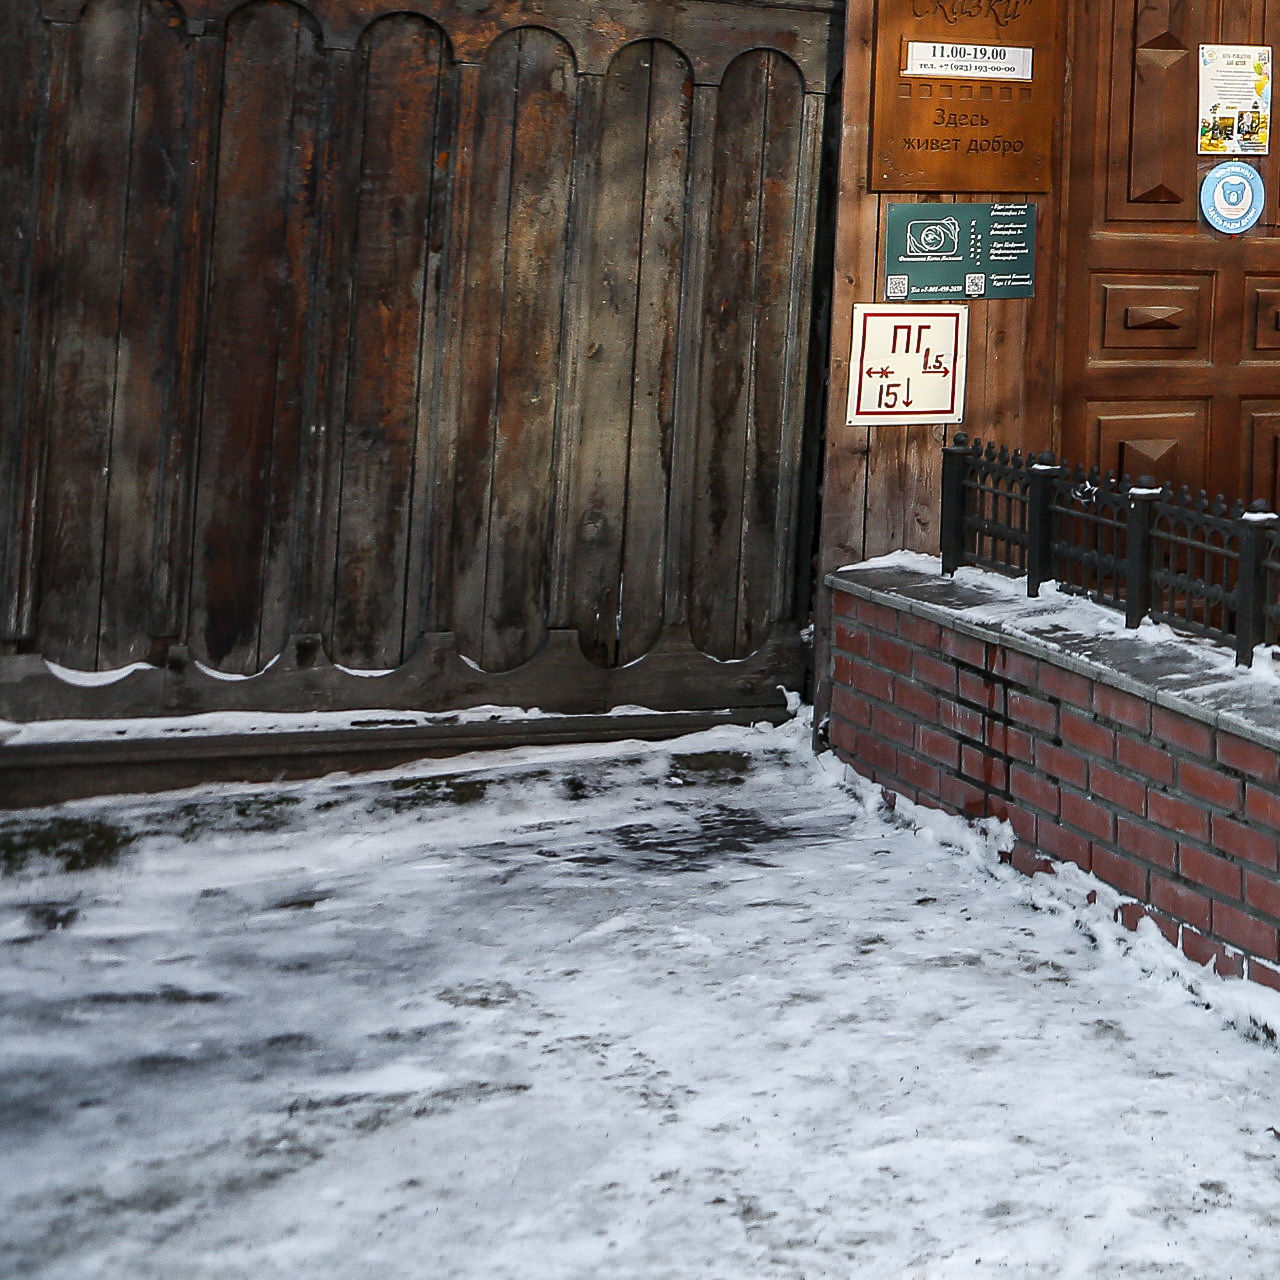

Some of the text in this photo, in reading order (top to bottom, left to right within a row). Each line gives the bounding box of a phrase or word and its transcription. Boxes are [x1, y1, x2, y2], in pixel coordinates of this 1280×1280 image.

[931, 45, 1007, 61] 11.00-19.00
[950, 63, 973, 73] (923)
[974, 64, 1016, 73] 193-00-00
[933, 107, 990, 128] Здесь
[903, 135, 1025, 157] живет добро
[891, 325, 931, 354] ПГ
[877, 384, 902, 409] 15
